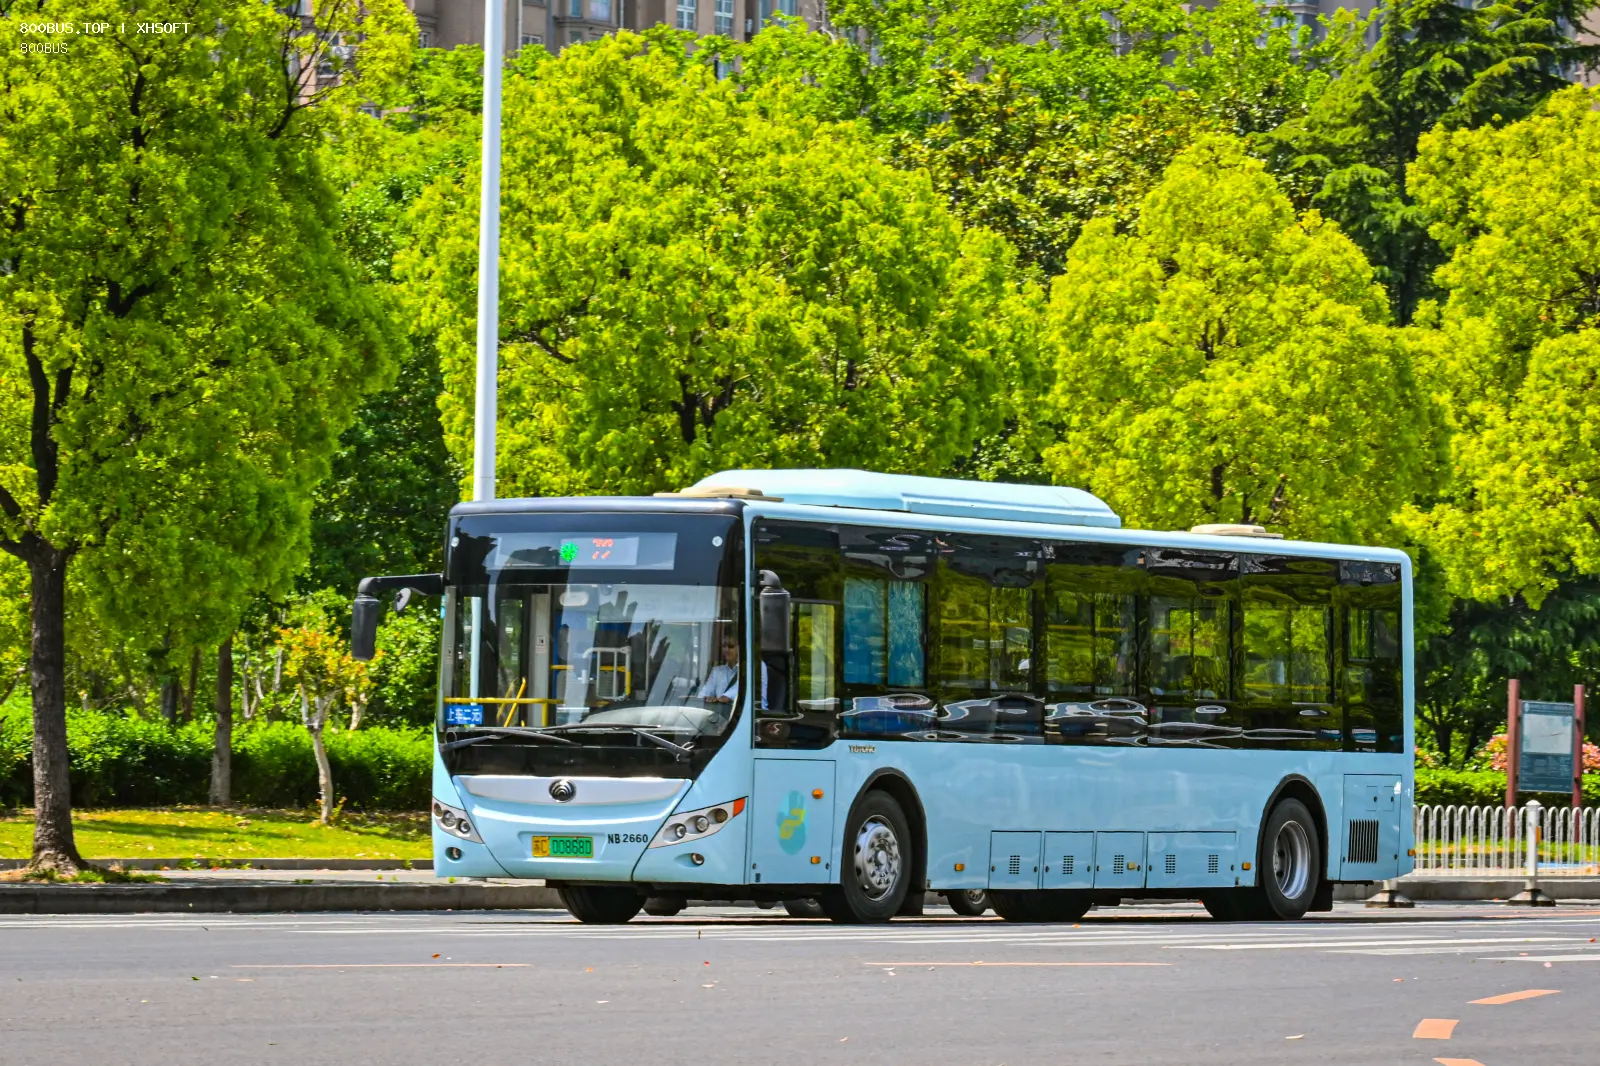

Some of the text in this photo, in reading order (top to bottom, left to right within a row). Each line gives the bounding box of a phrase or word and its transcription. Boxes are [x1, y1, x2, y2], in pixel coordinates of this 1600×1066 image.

[446, 707, 481, 722] 上车二元
[607, 833, 649, 844] NB 2660
